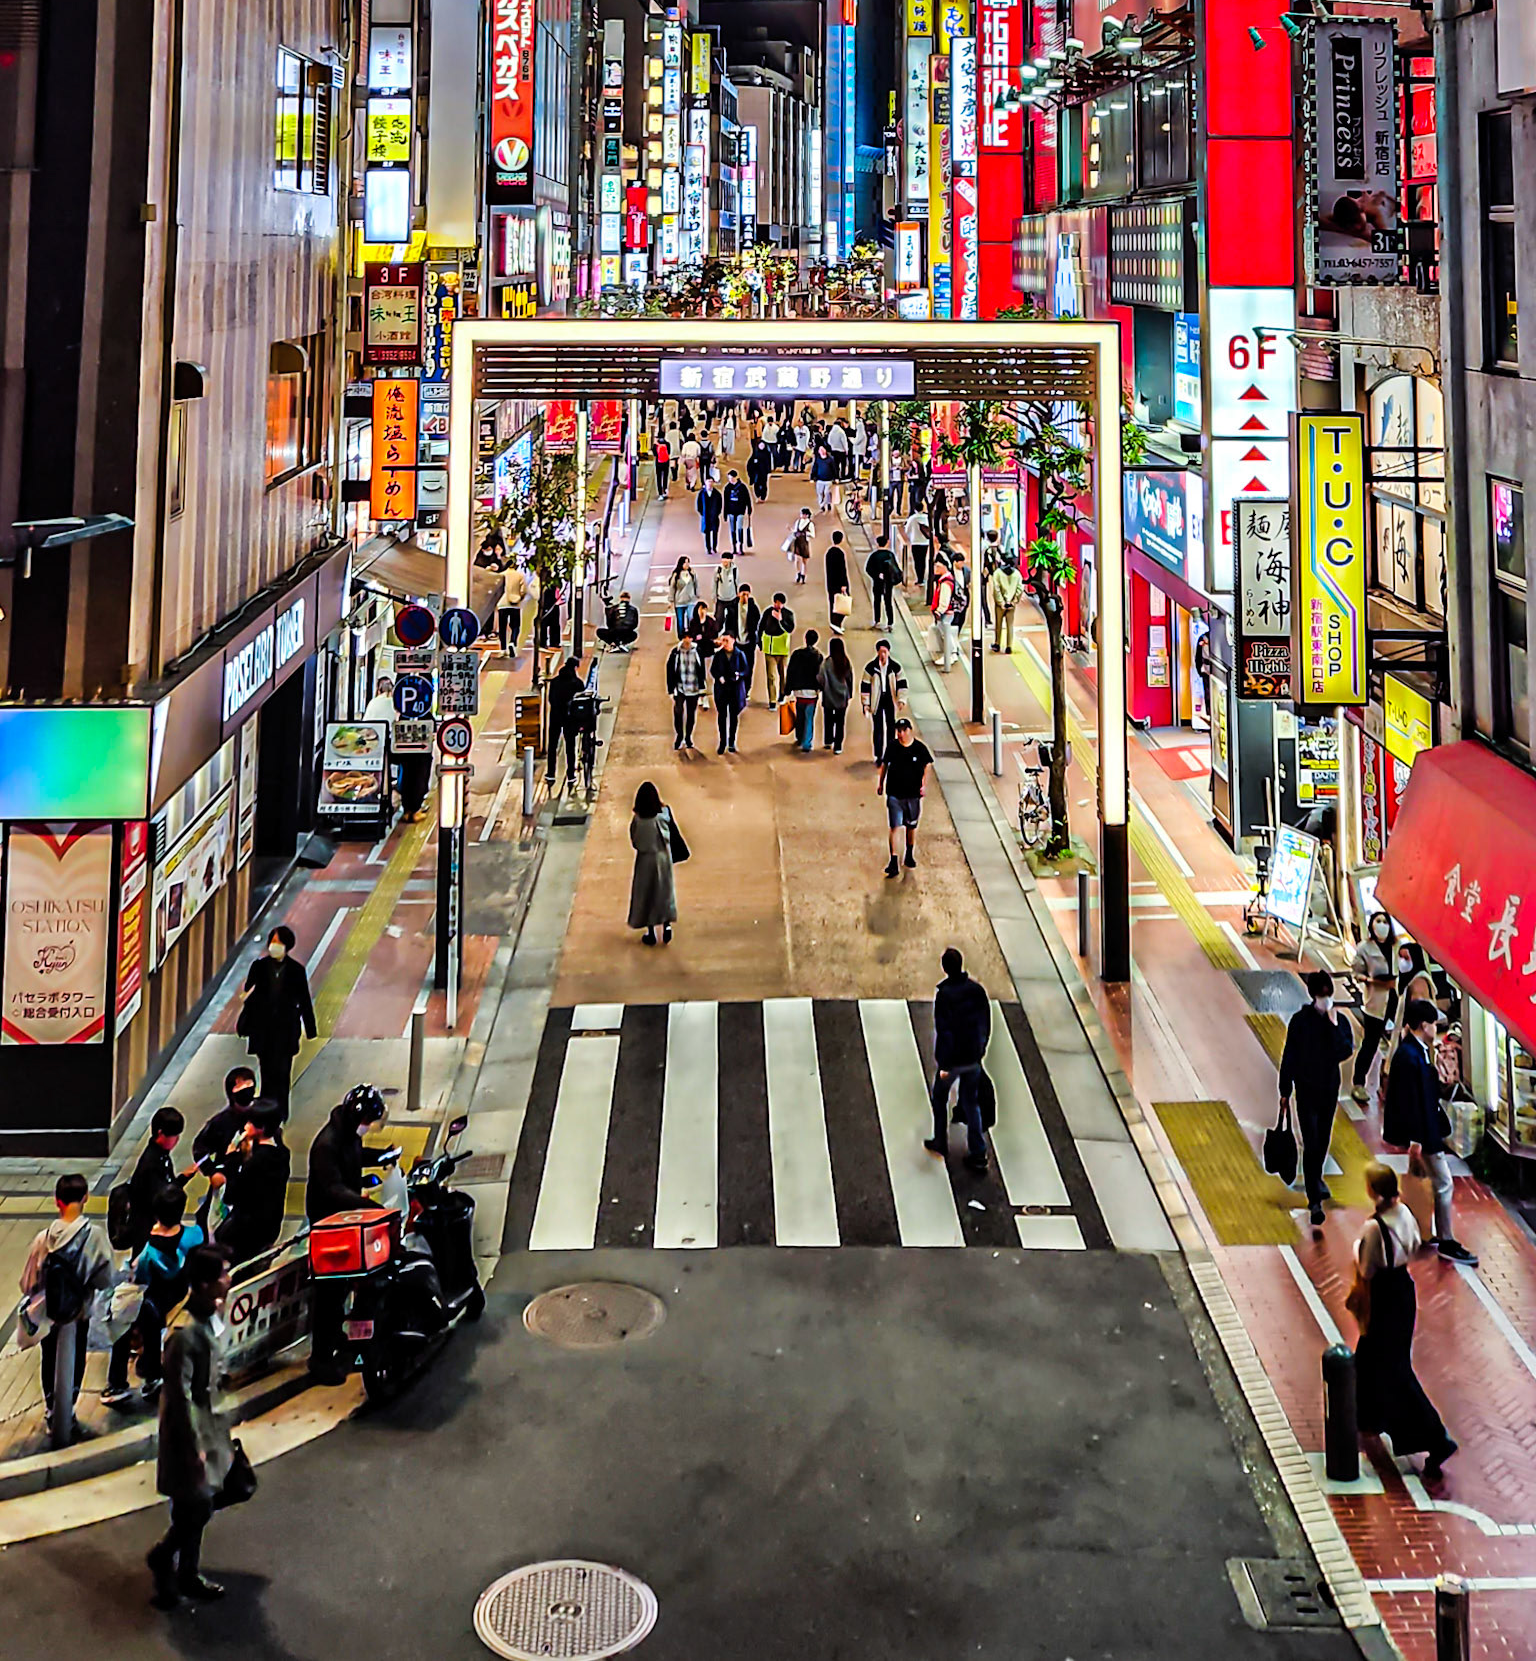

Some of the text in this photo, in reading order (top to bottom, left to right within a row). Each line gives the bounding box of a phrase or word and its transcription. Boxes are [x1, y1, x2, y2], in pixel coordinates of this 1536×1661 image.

[1334, 51, 1355, 170] Princess
[1373, 41, 1390, 177] リフレッシュ 新宿店
[1227, 334, 1278, 370] 6F
[679, 365, 894, 390] 新宿武蔵野通り
[381, 384, 408, 517] 俺流塩らーめん
[222, 597, 305, 723] PASELABO TOWER
[1252, 642, 1289, 659] Pizza
[1310, 598, 1325, 694] 新宿駅東南口店
[1328, 614, 1343, 677] SHOP
[401, 686, 418, 714] P
[412, 700, 425, 714] 40
[445, 728, 468, 749] 30
[1444, 863, 1481, 924] 食堂
[12, 992, 96, 1004] パセラボタワー
[23, 1006, 96, 1019] 総合受付入口
